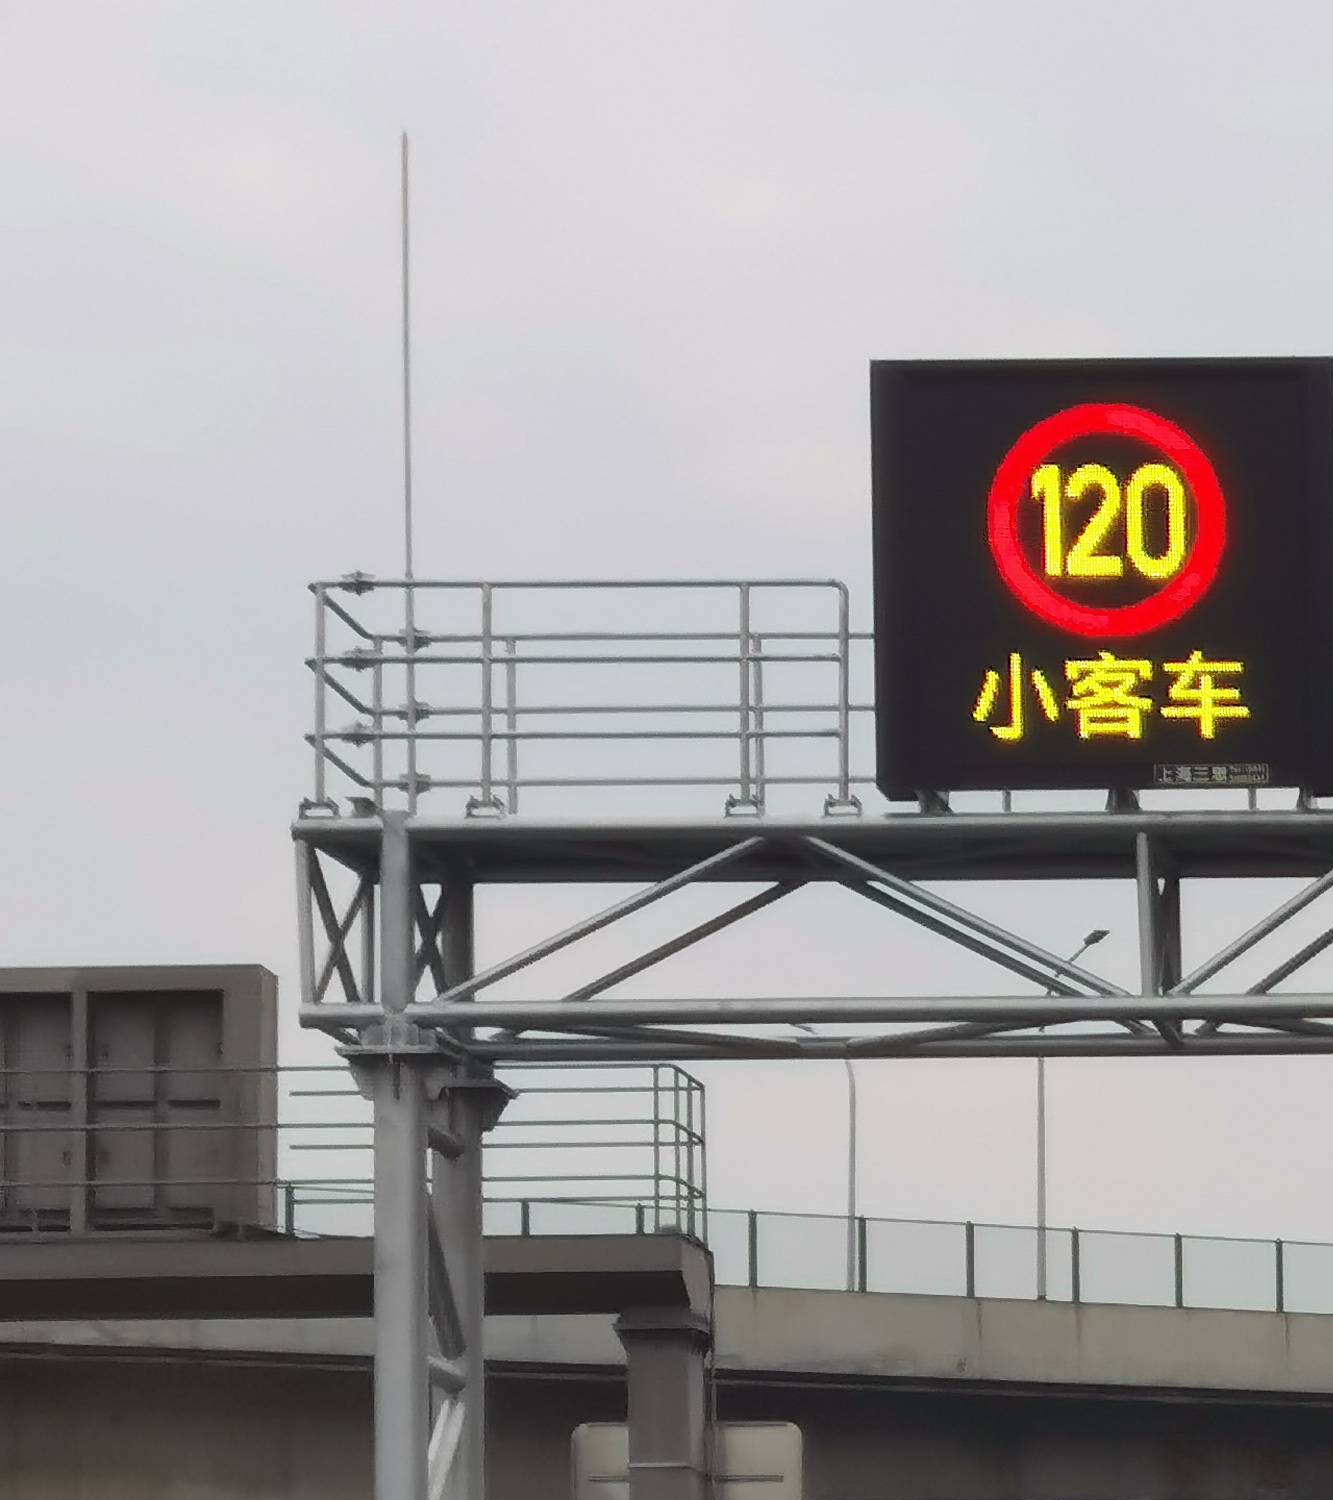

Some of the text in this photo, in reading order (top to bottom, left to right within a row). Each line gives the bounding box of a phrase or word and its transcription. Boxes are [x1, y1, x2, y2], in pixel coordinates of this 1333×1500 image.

[1034, 464, 1186, 579] 120
[973, 651, 1251, 741] 小客车
